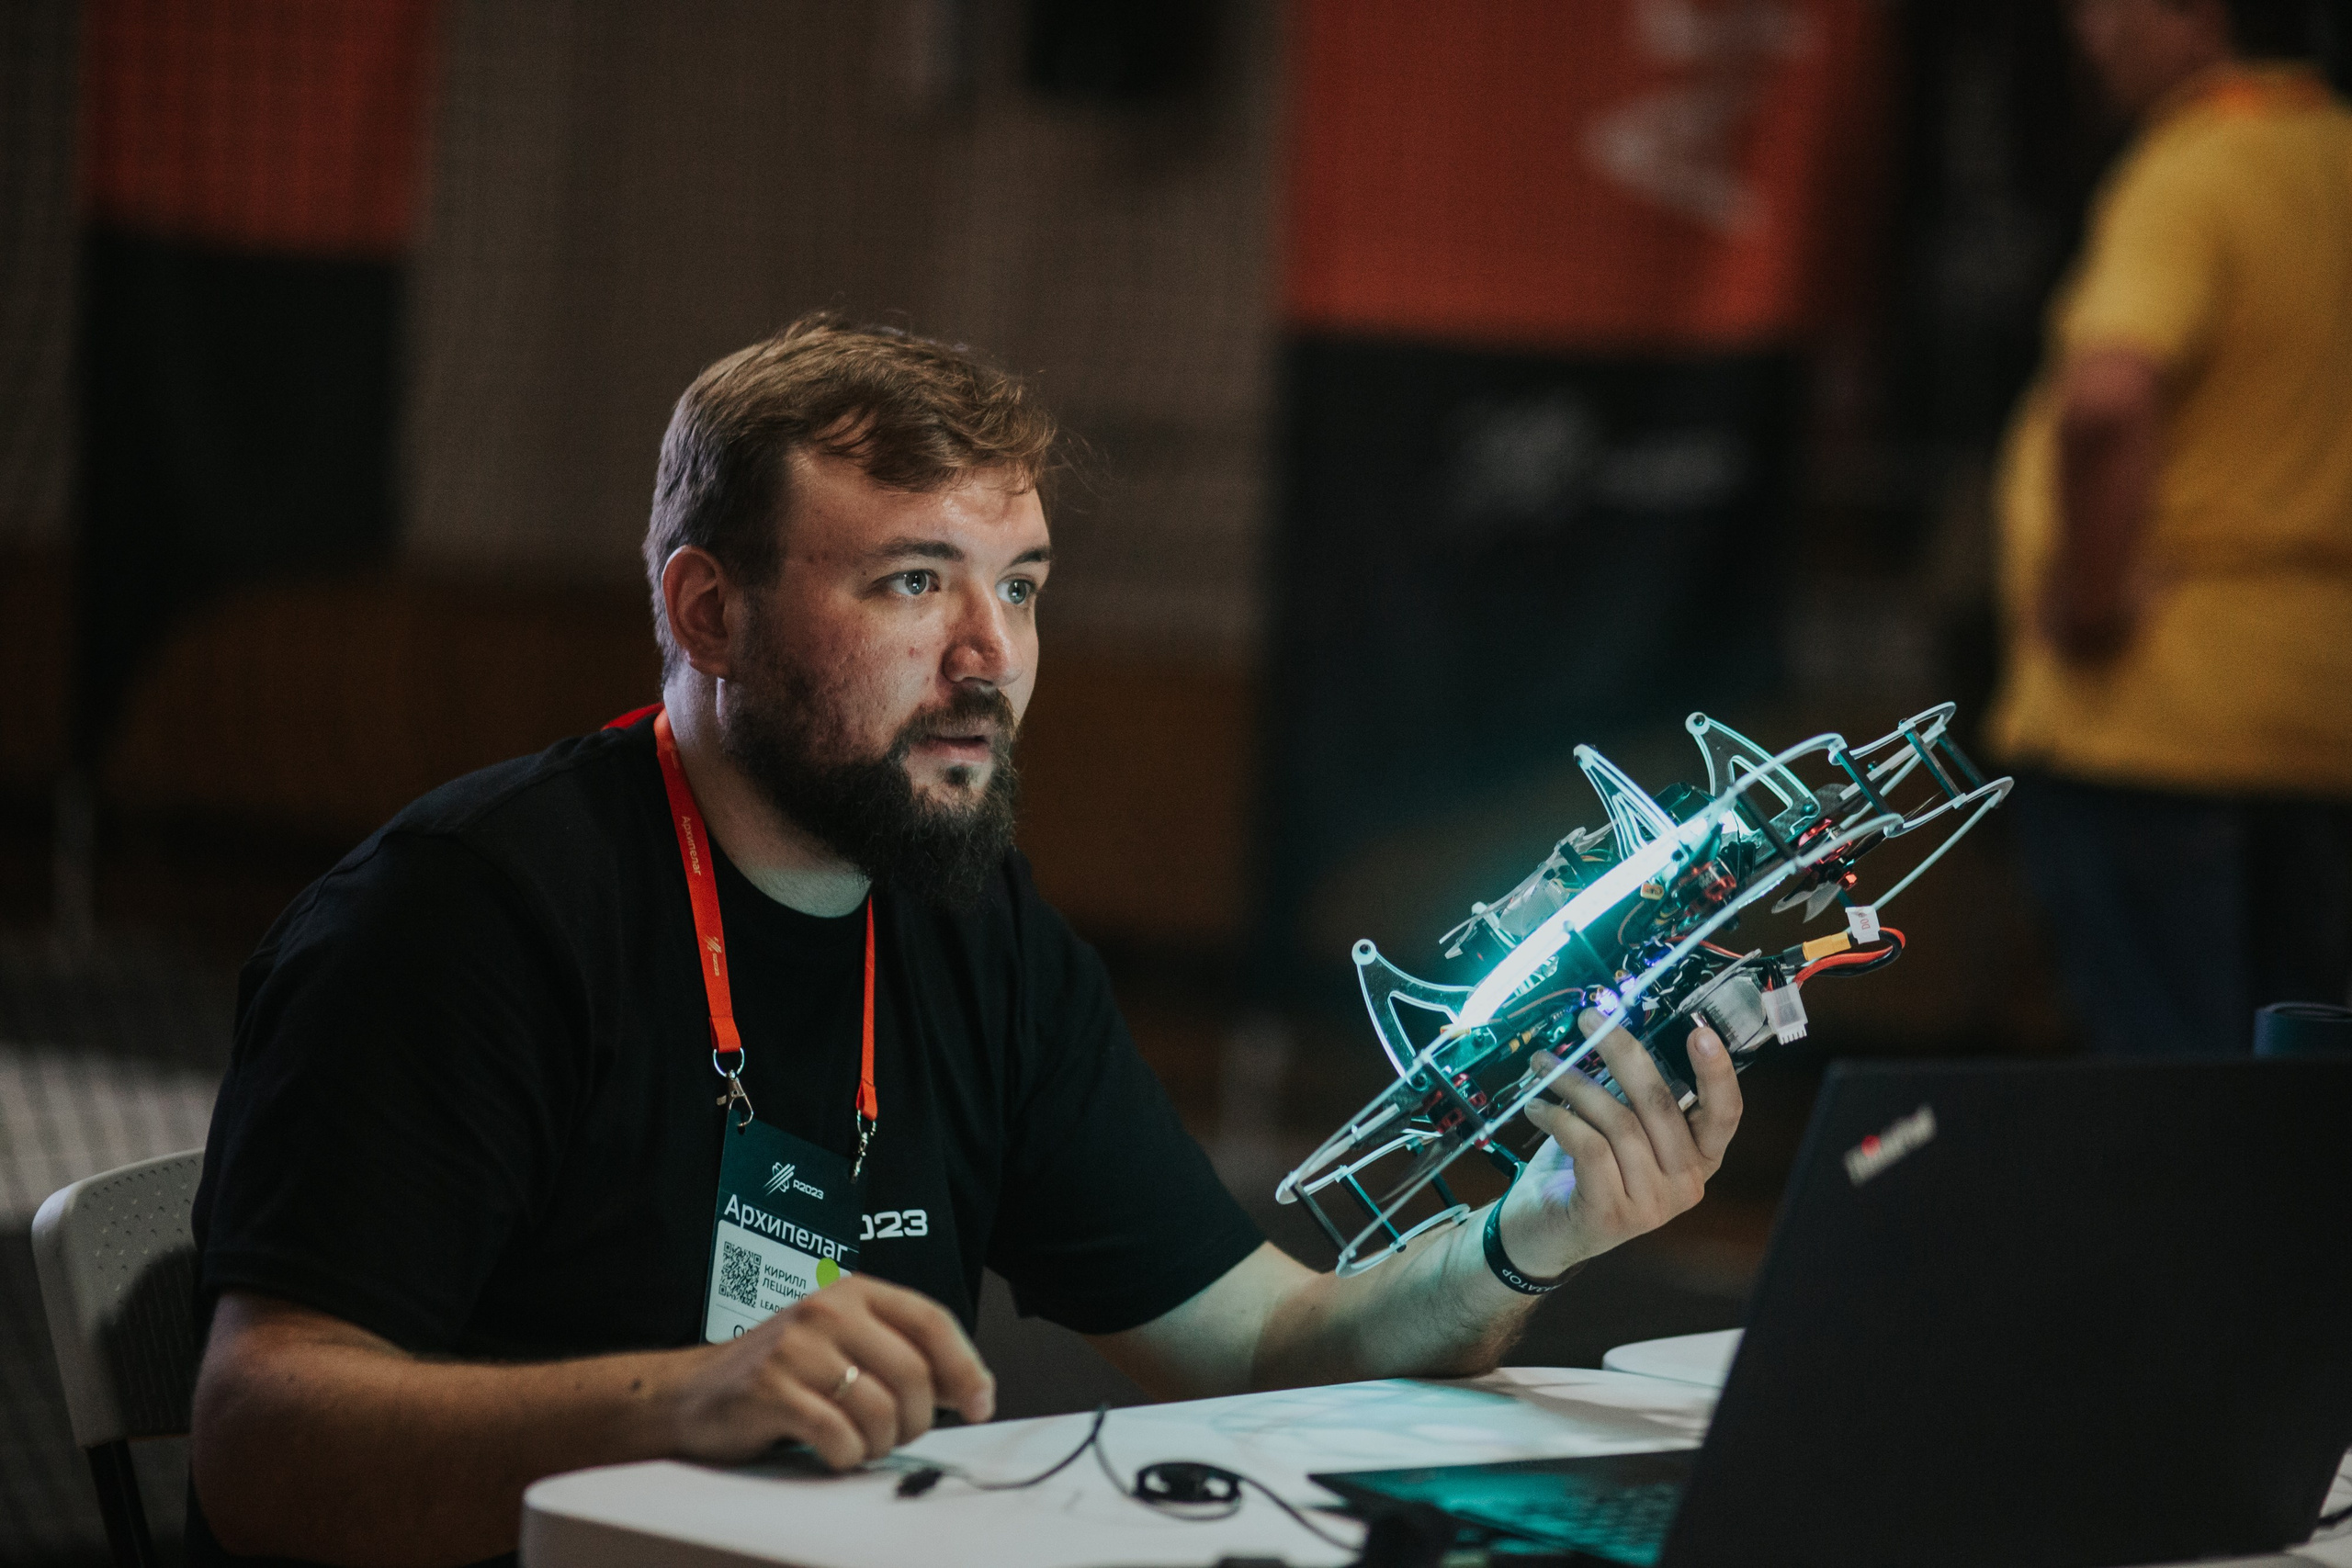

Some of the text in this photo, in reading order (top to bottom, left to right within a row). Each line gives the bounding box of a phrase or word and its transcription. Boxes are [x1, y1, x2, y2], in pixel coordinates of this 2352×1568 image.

[681, 816, 701, 876] Архипелаг
[724, 1193, 848, 1261] Архипелаг
[763, 1264, 807, 1289] КИРИЛЛ
